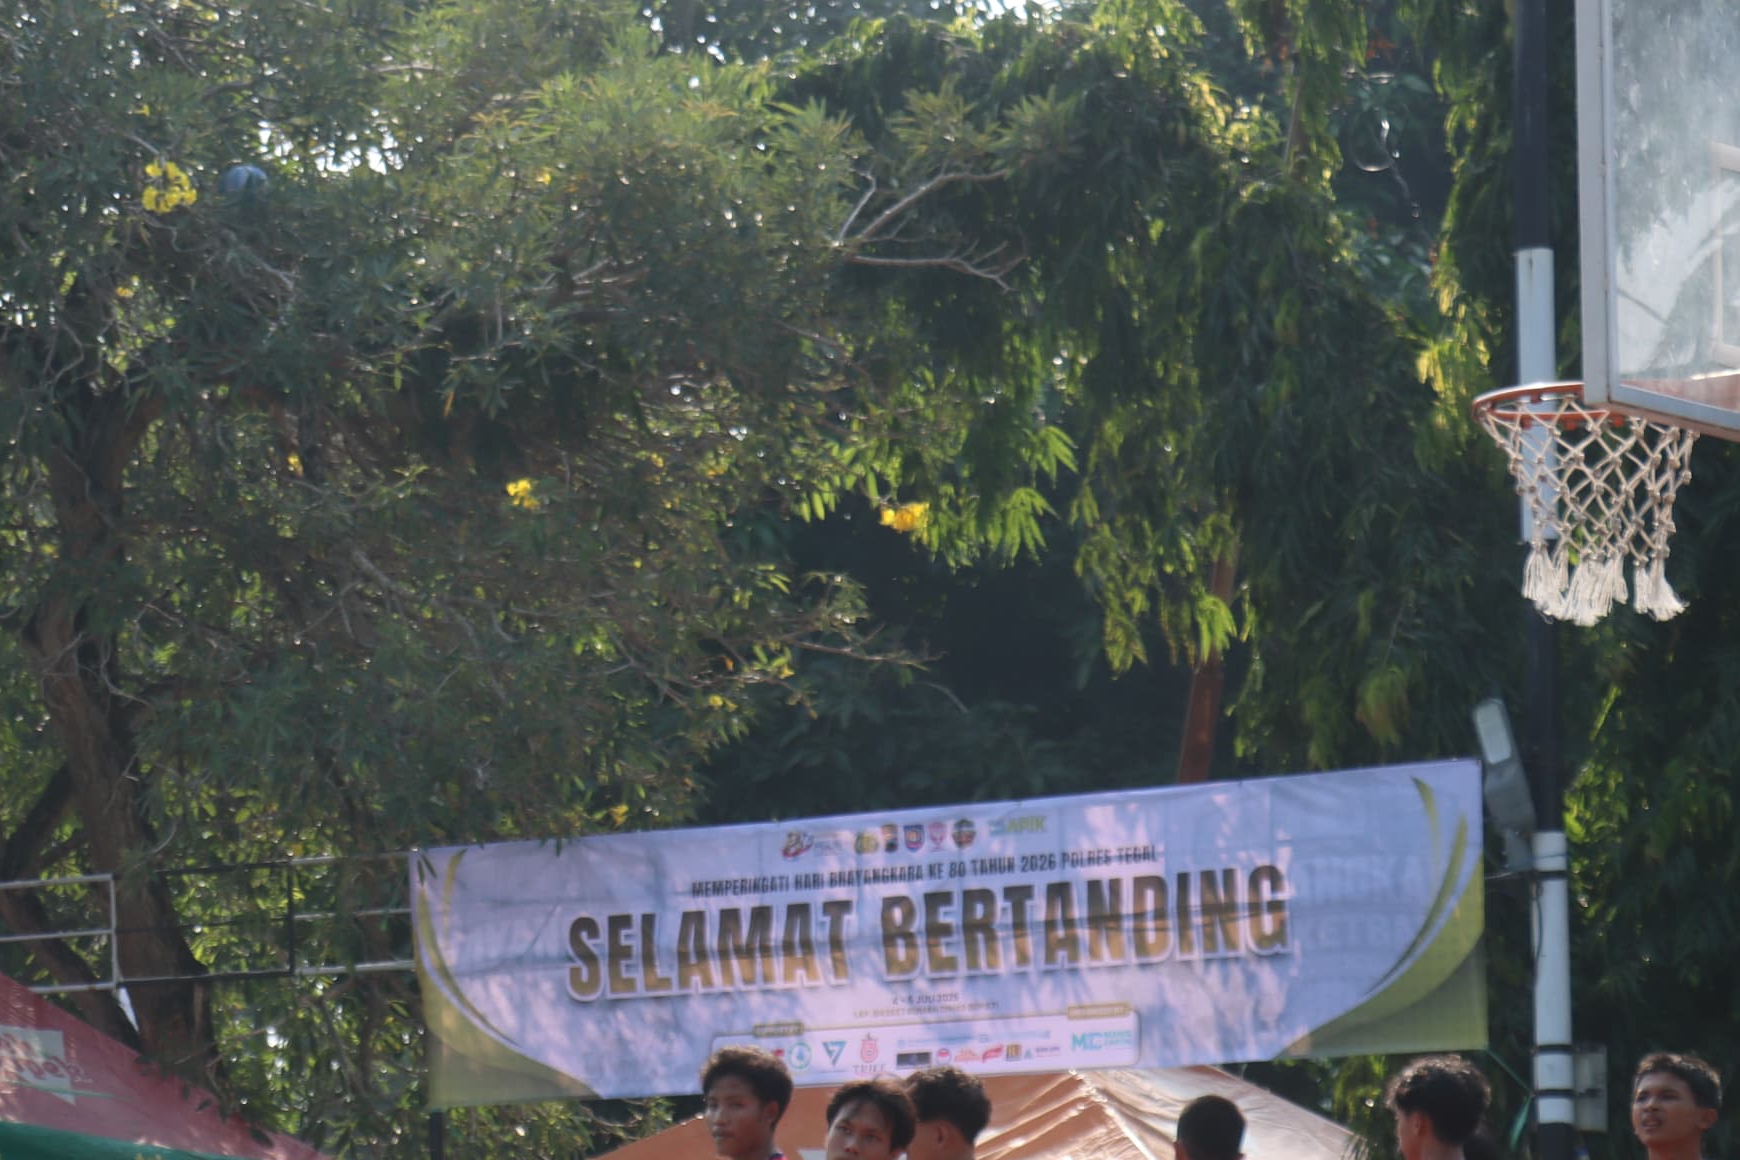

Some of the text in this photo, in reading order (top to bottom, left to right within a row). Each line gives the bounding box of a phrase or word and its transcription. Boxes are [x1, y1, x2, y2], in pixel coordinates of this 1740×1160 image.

[691, 875, 790, 898] MEMPERINGATI
[795, 870, 825, 891] HARI
[928, 862, 944, 881] KE
[948, 860, 967, 879] 80
[971, 856, 1016, 876] TAHUN
[1020, 853, 1057, 874] 2026
[1061, 848, 1112, 869] POLRES
[1115, 844, 1158, 864] TEGAL
[568, 899, 854, 998] SELAMAT
[880, 863, 1290, 978] BERTANDING
